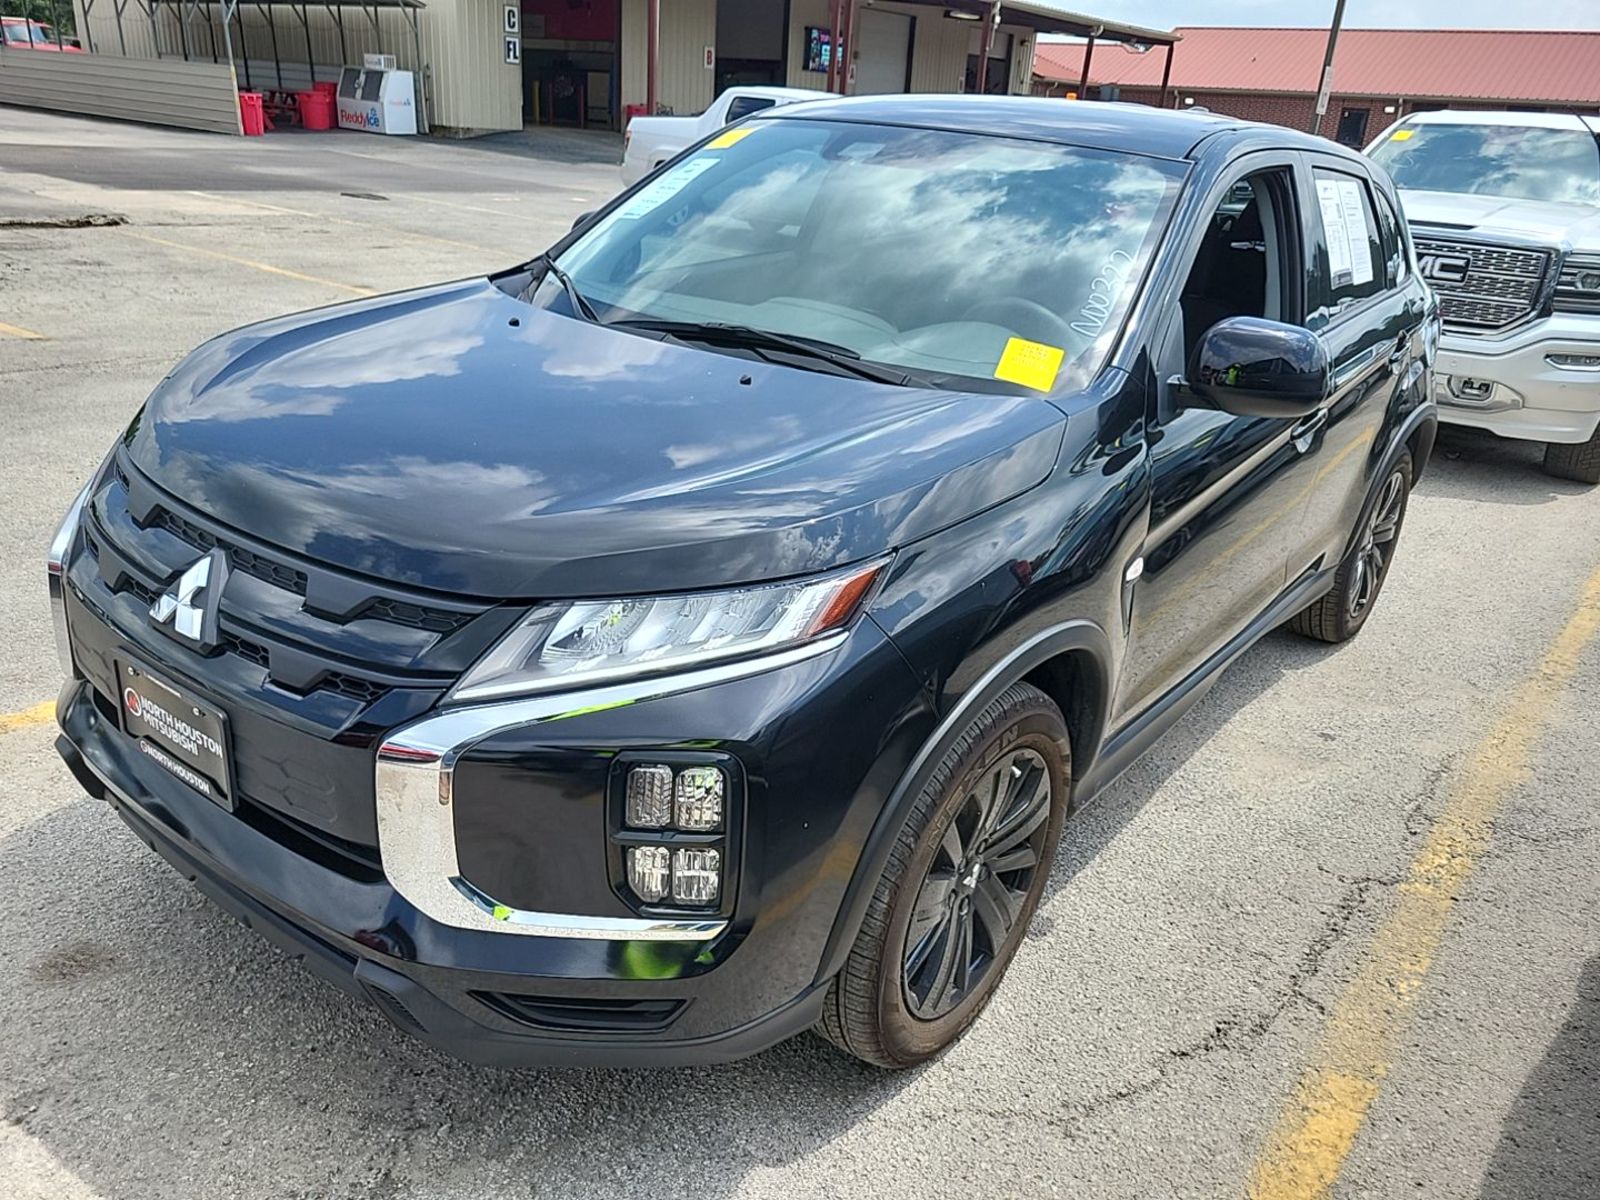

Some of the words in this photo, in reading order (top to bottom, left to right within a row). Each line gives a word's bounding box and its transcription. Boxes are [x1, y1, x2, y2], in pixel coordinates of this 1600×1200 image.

[507, 9, 516, 29] C
[507, 40, 519, 60] FL
[706, 49, 713, 66] B
[1418, 255, 1468, 281] MC
[140, 695, 174, 727] NORTH
[174, 715, 223, 758] HOUSTON
[142, 709, 199, 756] MITSUBISHI
[173, 761, 210, 794] HOUSTON
